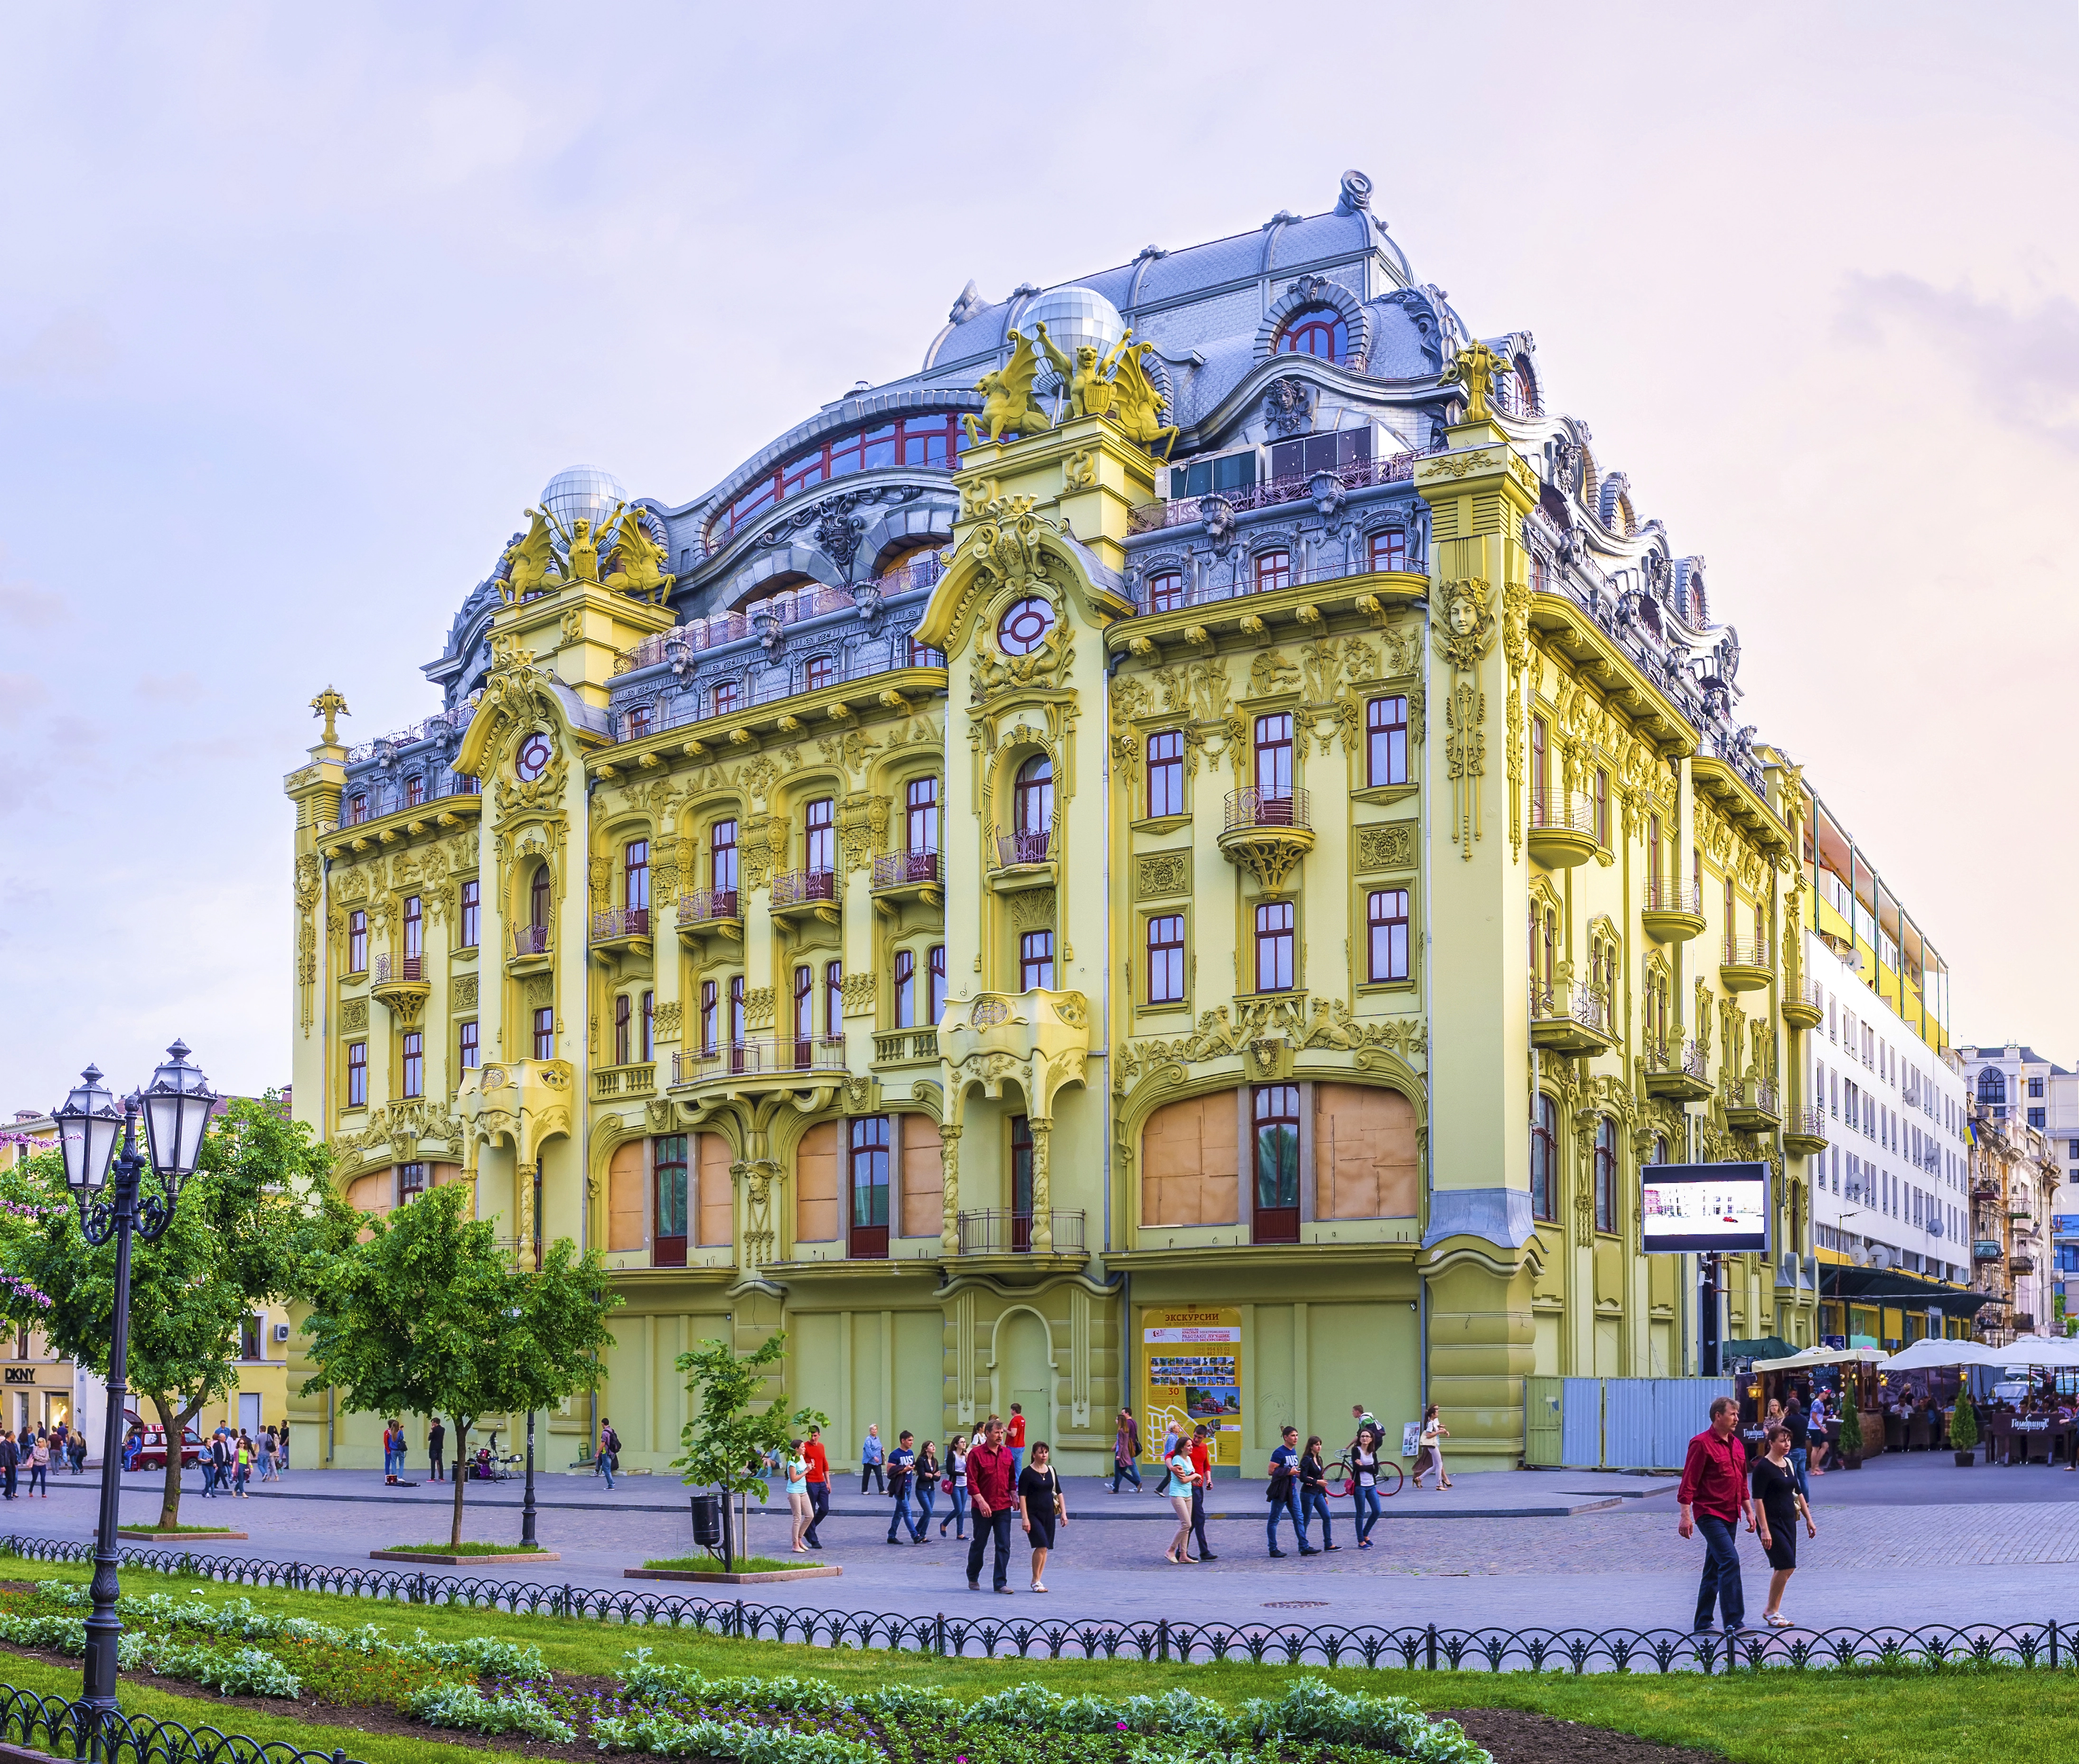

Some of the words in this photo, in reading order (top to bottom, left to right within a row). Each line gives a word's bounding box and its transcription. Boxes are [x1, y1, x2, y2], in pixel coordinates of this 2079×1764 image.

[1087, 388, 1106, 408] 2003
[1165, 1313, 1219, 1321] ЭКСКУРСИИ
[5, 1368, 35, 1381] DKNY
[1168, 1387, 1179, 1395] 30
[899, 1455, 913, 1465] JUS
[1284, 1455, 1298, 1466] JUS
